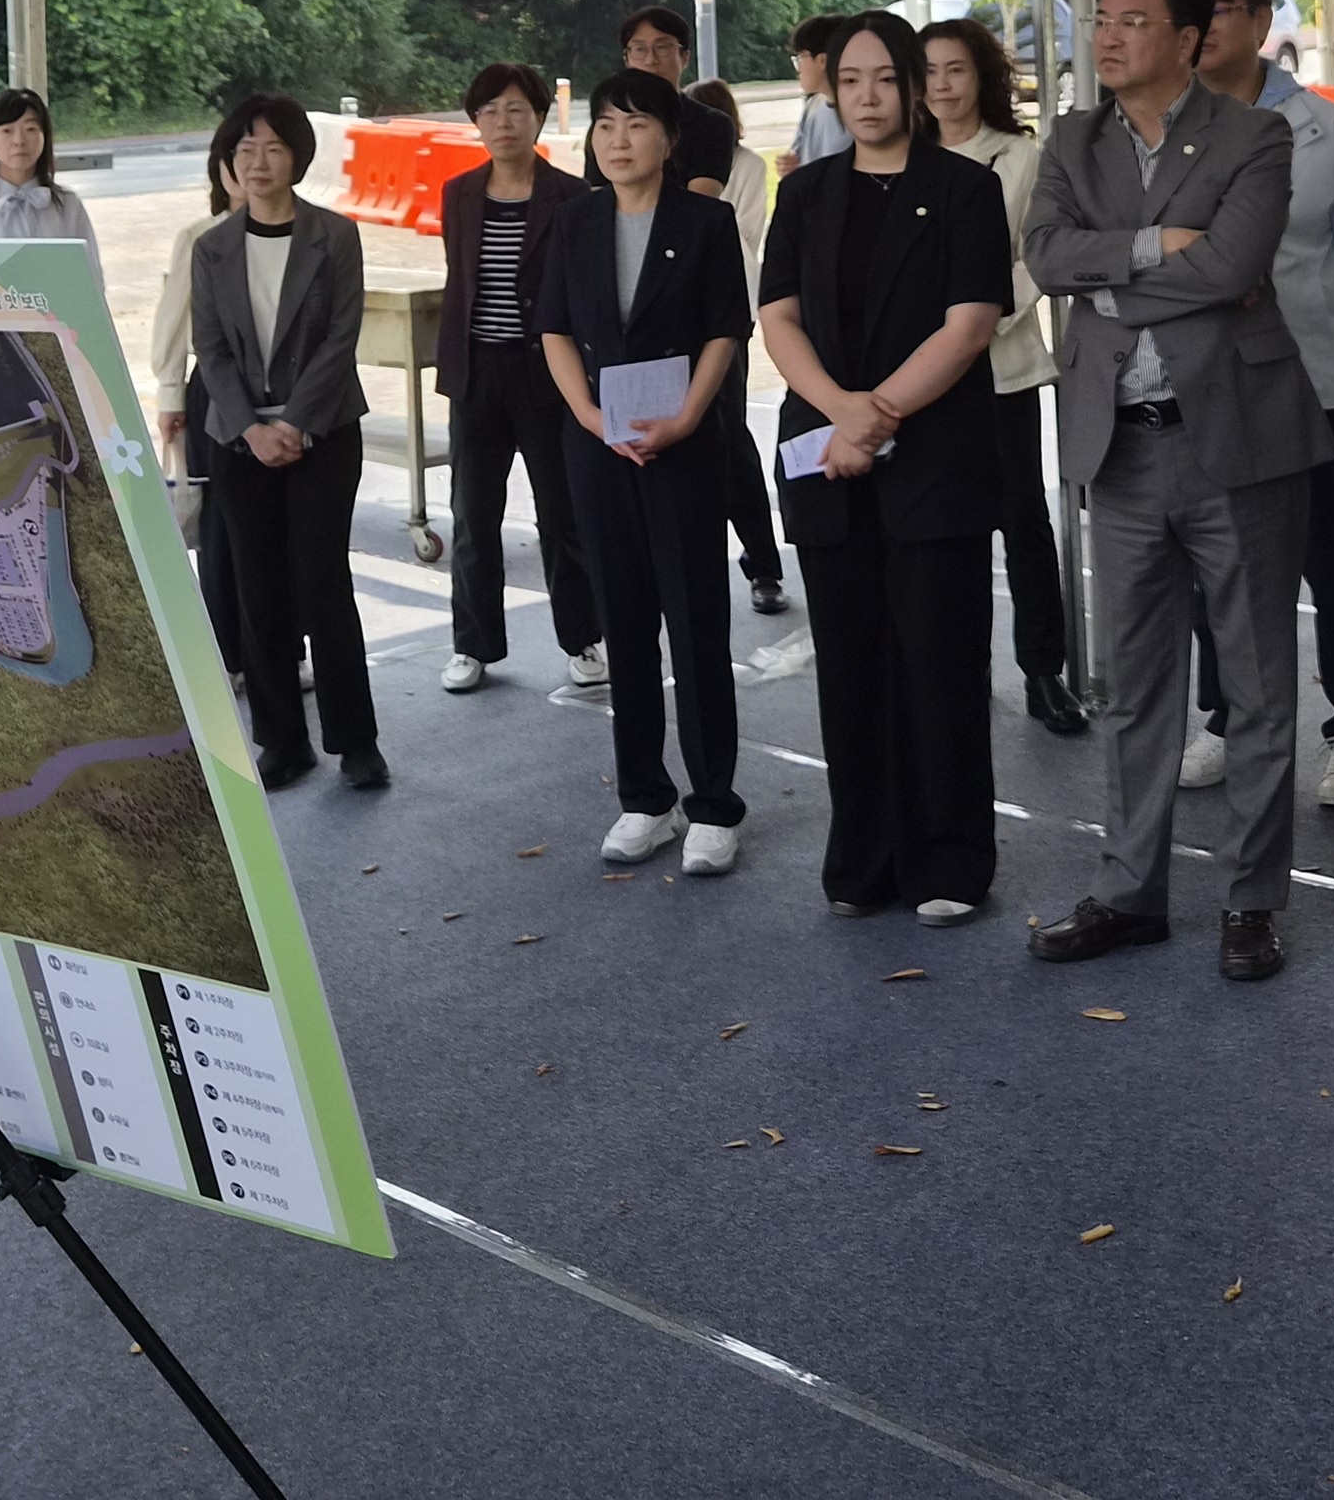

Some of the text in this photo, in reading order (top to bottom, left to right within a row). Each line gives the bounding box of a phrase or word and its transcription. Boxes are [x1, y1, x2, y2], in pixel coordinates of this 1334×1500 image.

[63, 960, 89, 976] 화장실
[73, 996, 97, 1011] 안내소
[33, 990, 61, 1058] 편의시설
[85, 1037, 111, 1053] 의료실
[158, 1023, 182, 1076] 주차장
[106, 1112, 131, 1128] 수유실
[117, 1151, 141, 1167] 흡연실
